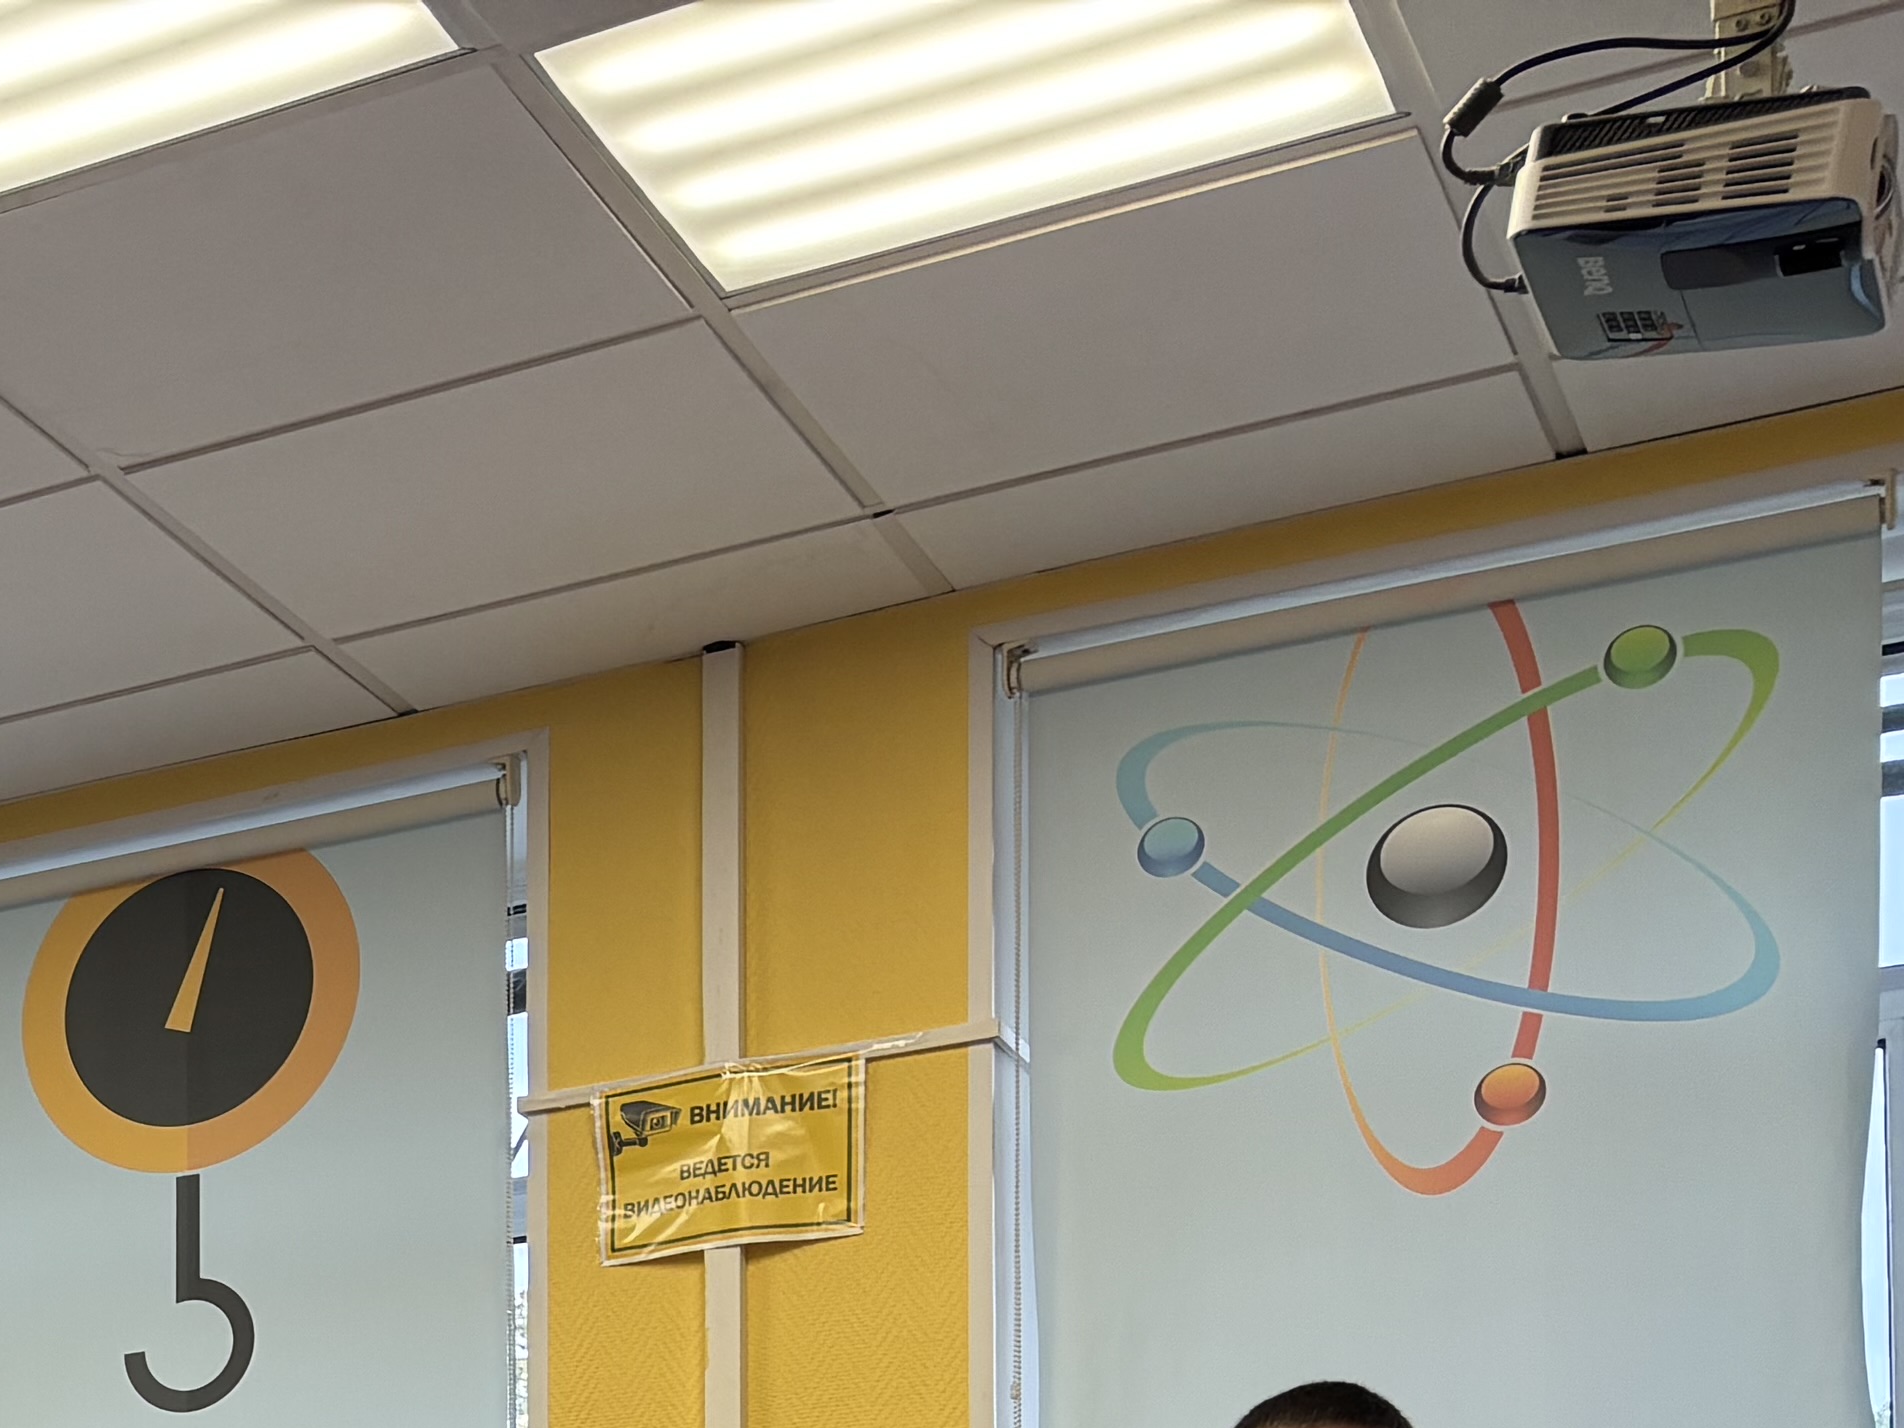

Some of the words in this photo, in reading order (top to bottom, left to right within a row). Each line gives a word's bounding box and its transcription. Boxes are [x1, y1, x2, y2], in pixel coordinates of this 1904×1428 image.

[690, 1088, 838, 1125] ВНИМАНИЕ!
[680, 1151, 770, 1181] ВЕДЕТСЯ
[623, 1174, 839, 1219] ВИДЕОНАБЛЮДЕНИЕ
